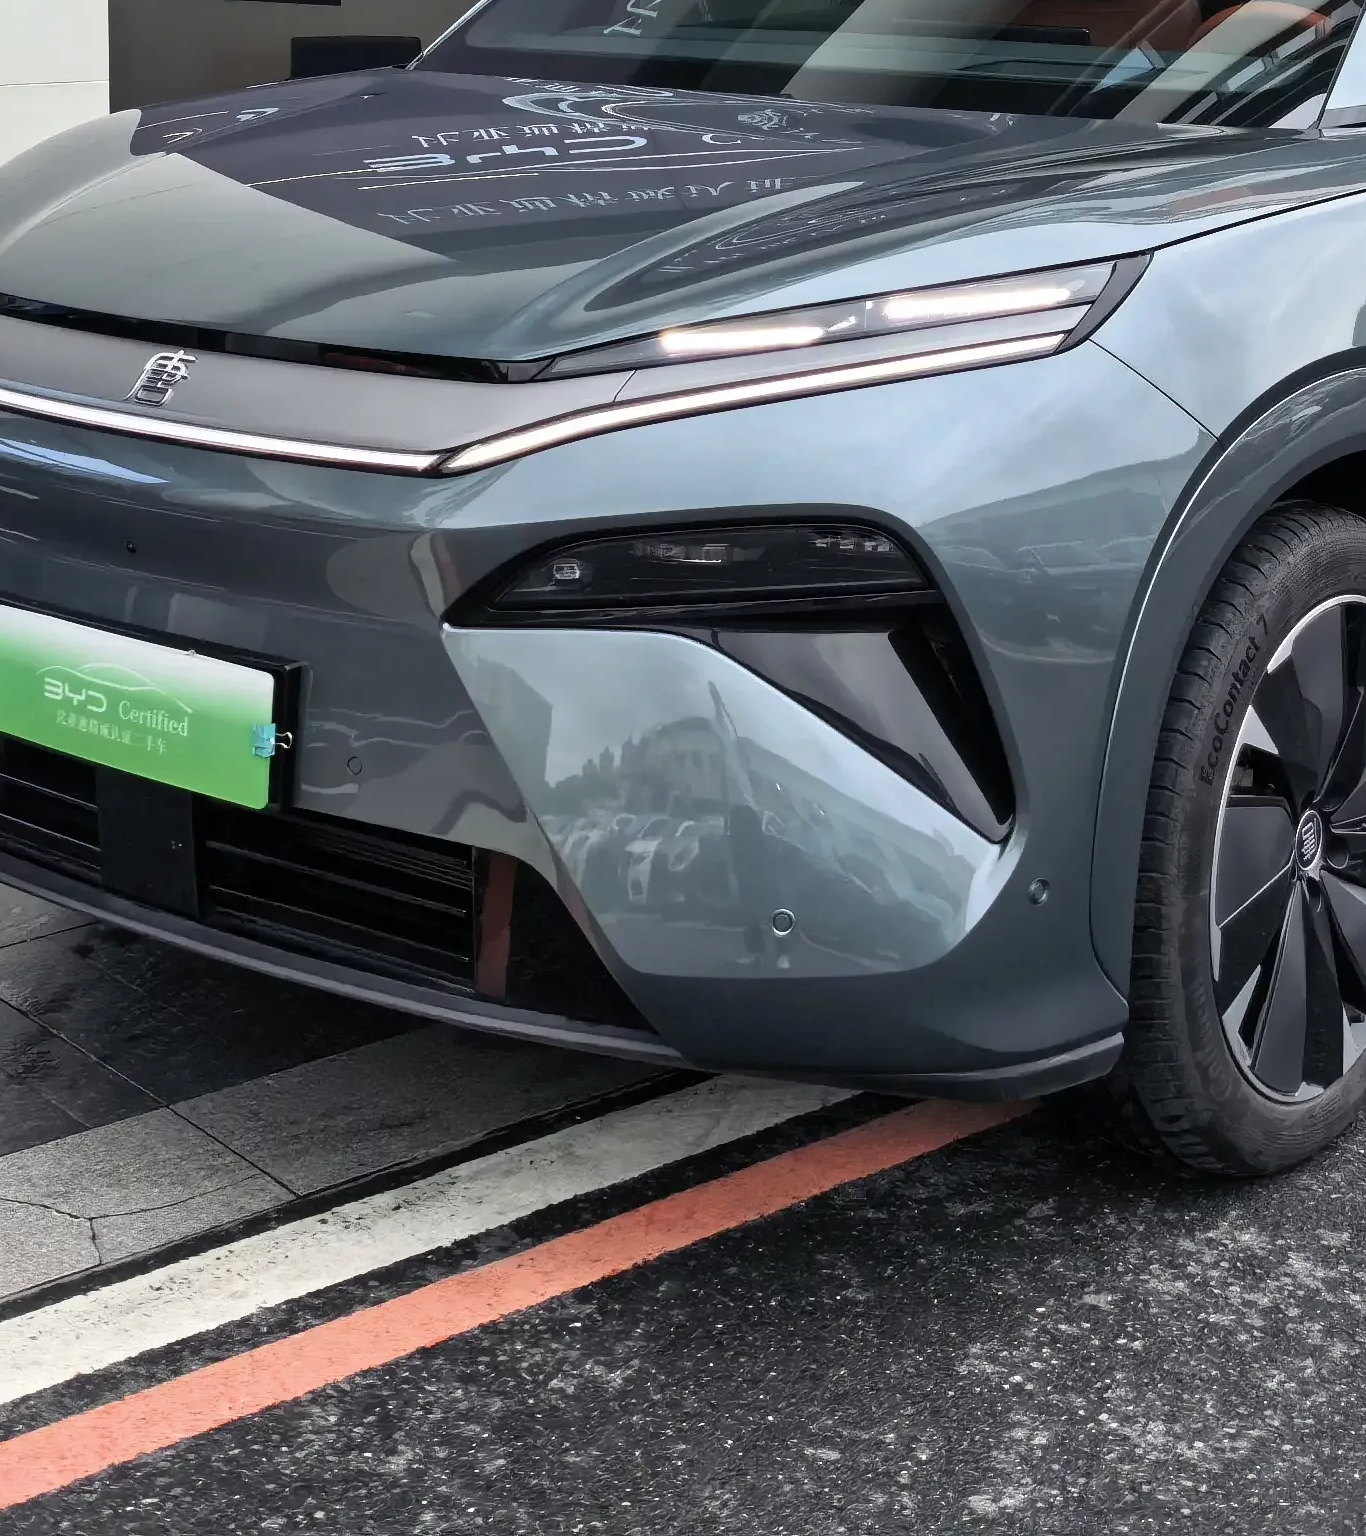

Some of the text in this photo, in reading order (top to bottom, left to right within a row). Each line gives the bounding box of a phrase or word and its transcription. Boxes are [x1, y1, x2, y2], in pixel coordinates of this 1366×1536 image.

[44, 677, 189, 737] BYD Certified
[1198, 613, 1268, 785] EcoContact 7
